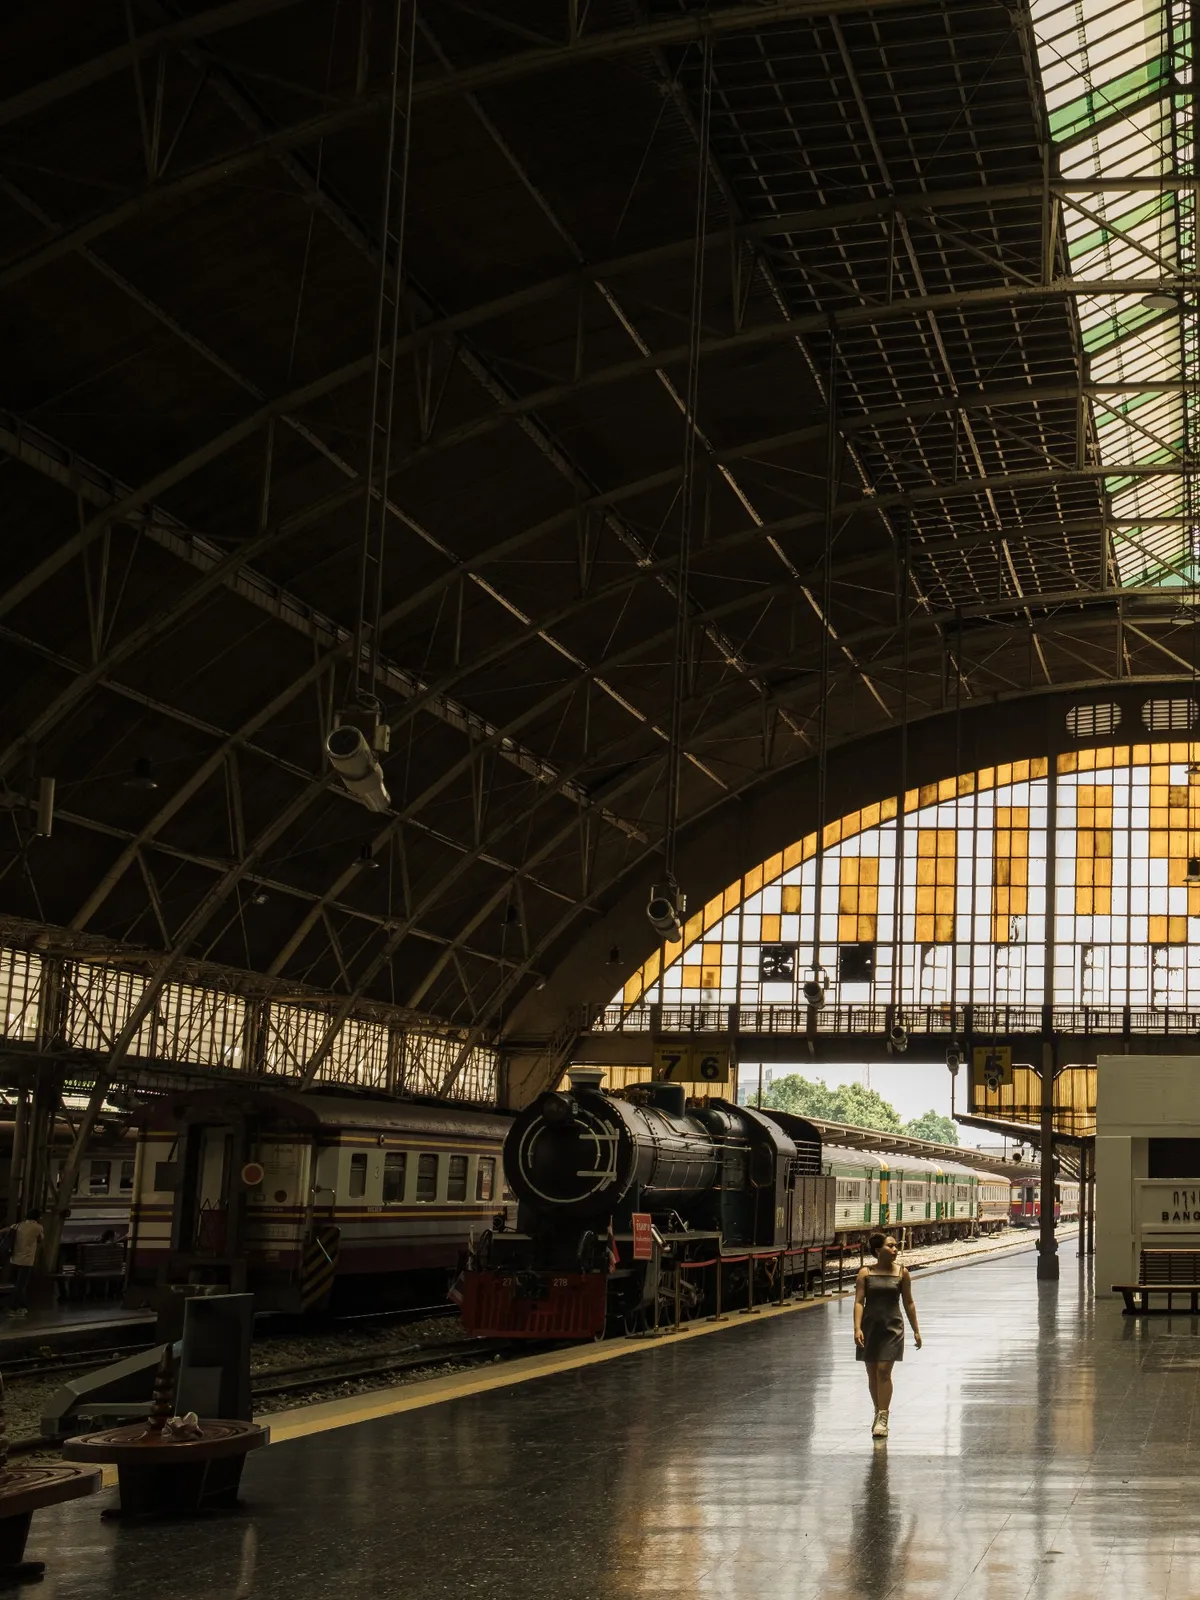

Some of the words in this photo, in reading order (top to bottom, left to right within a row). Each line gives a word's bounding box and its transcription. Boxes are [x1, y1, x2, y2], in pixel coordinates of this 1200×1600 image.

[661, 1055, 681, 1079] 7
[701, 1056, 719, 1080] 6
[984, 1055, 1005, 1081] 5
[553, 1278, 569, 1287] 278
